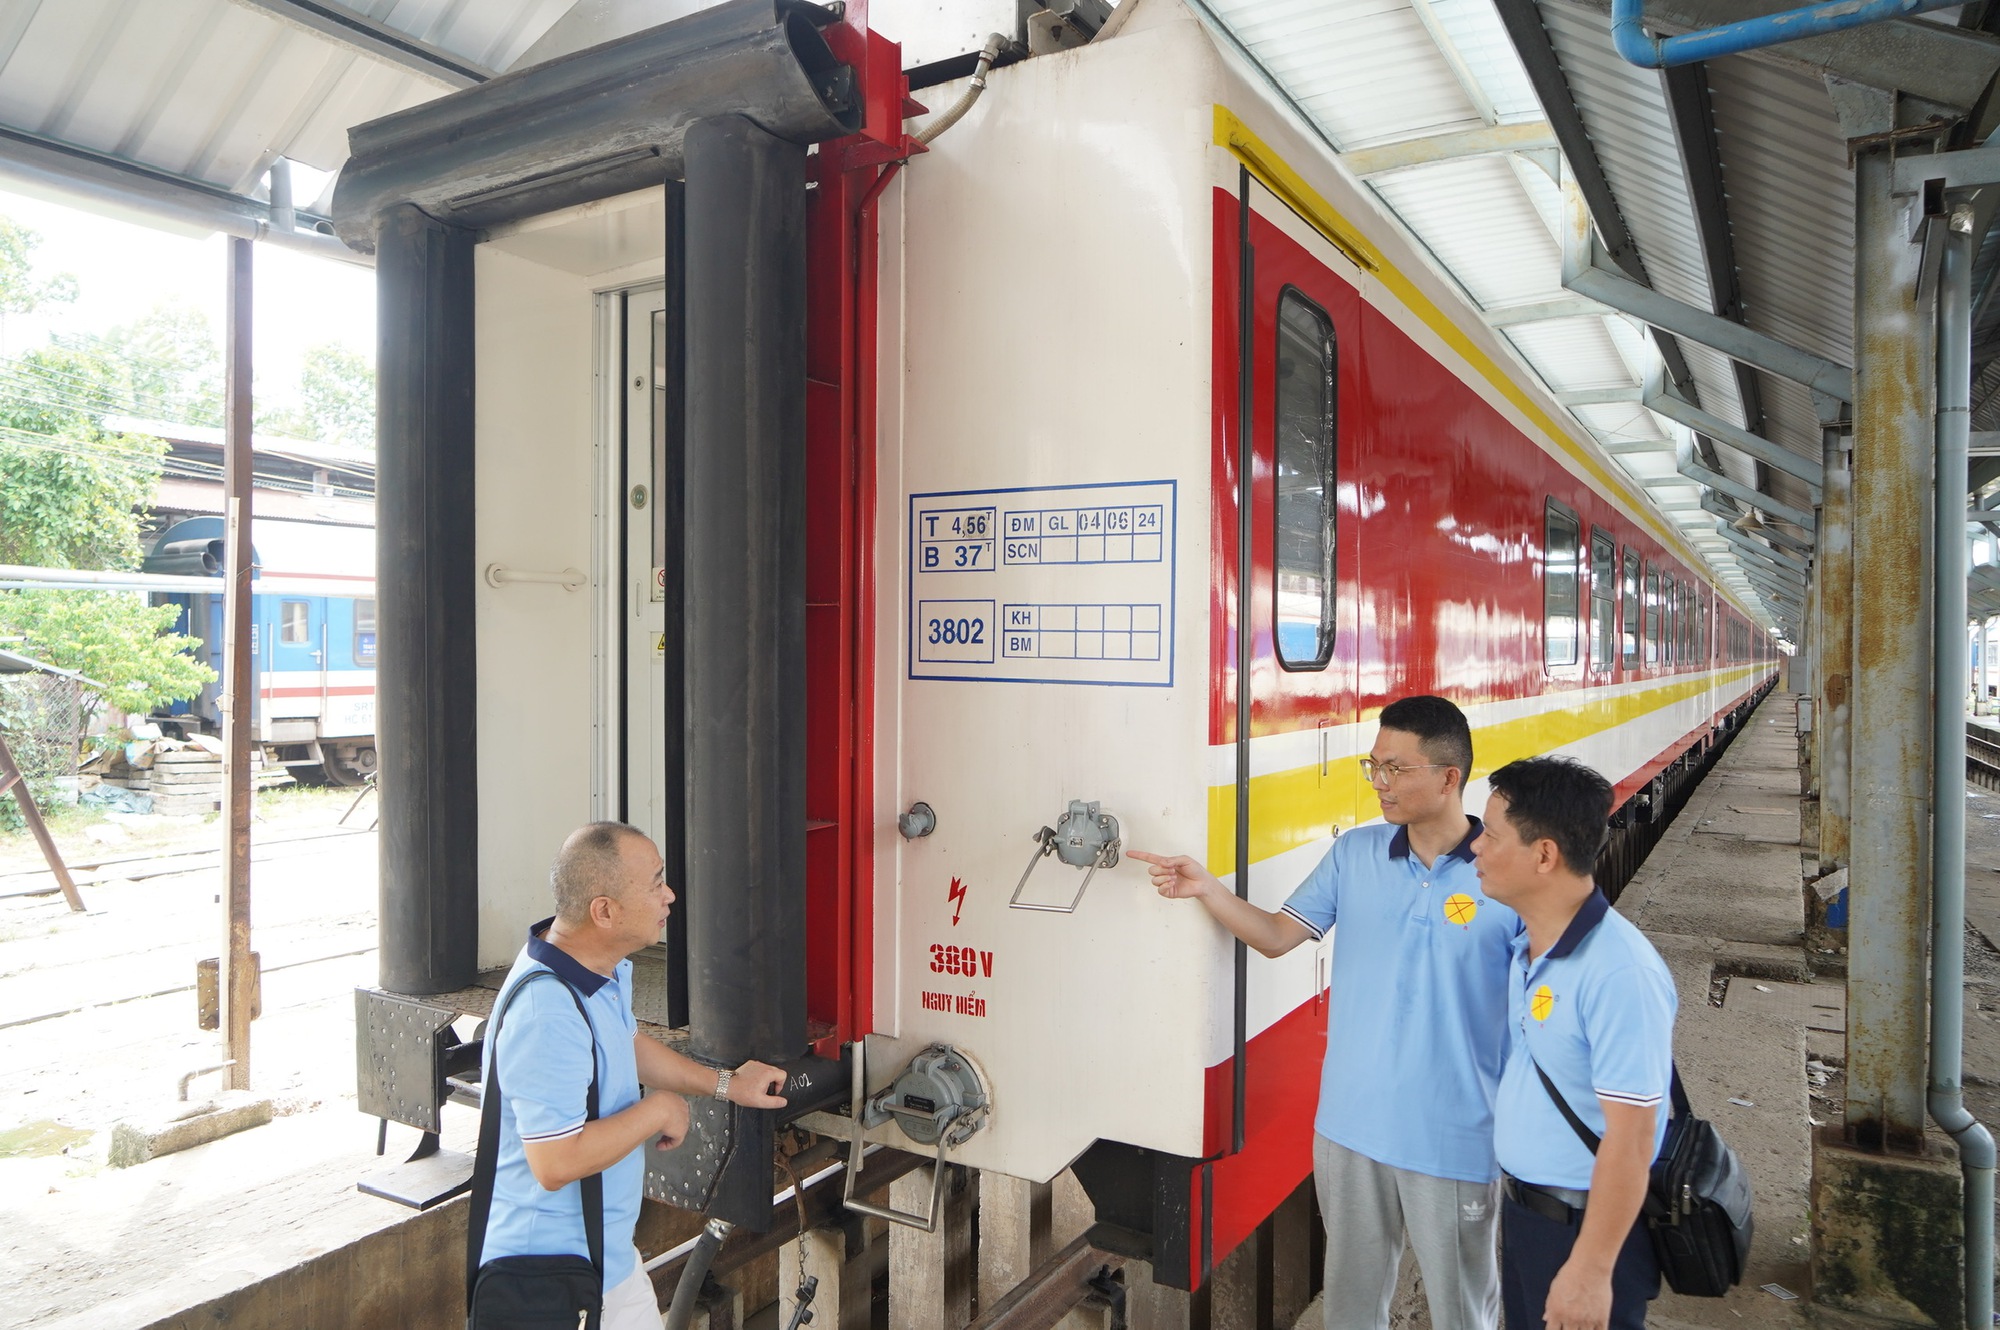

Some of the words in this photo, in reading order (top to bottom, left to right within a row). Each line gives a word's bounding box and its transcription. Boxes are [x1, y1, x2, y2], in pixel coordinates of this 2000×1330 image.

[925, 516, 940, 537] T
[1048, 515, 1069, 531] GL
[1079, 511, 1101, 531] 04
[1107, 511, 1128, 530] 06
[1138, 512, 1156, 528] 24
[925, 546, 940, 567] B
[1007, 543, 1038, 559] SCN
[1011, 610, 1032, 625] KH
[928, 618, 985, 645] 3802
[1010, 637, 1032, 652] BM
[922, 990, 953, 1013] NGUY
[956, 990, 986, 1018] HIỂM
